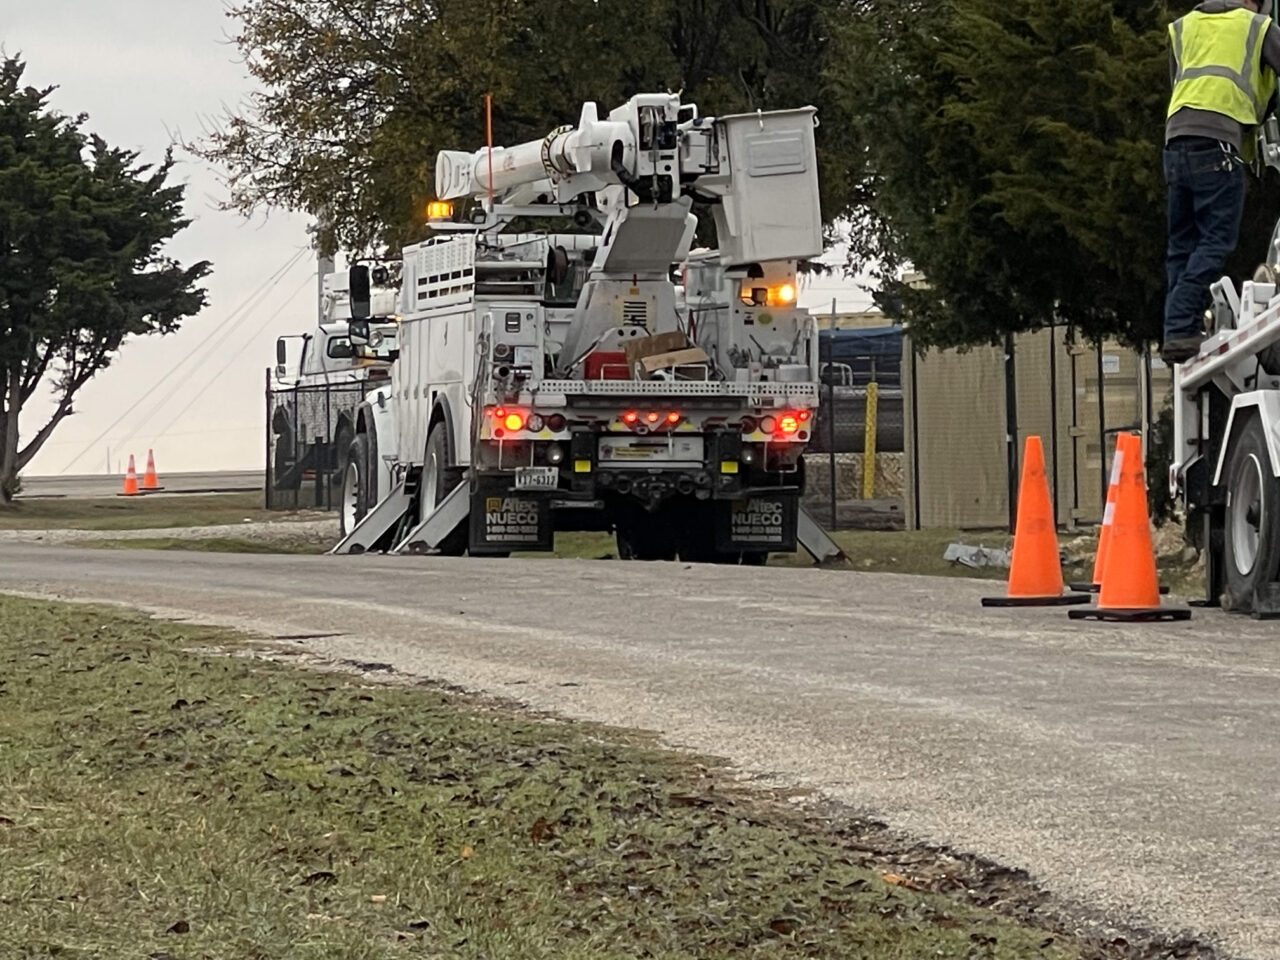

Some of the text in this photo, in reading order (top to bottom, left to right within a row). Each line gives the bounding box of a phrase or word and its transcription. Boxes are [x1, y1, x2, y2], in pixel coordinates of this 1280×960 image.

[502, 498, 538, 513] Altec
[747, 499, 783, 513] Altec
[486, 513, 538, 525] NUECO
[732, 513, 782, 525] NUECO
